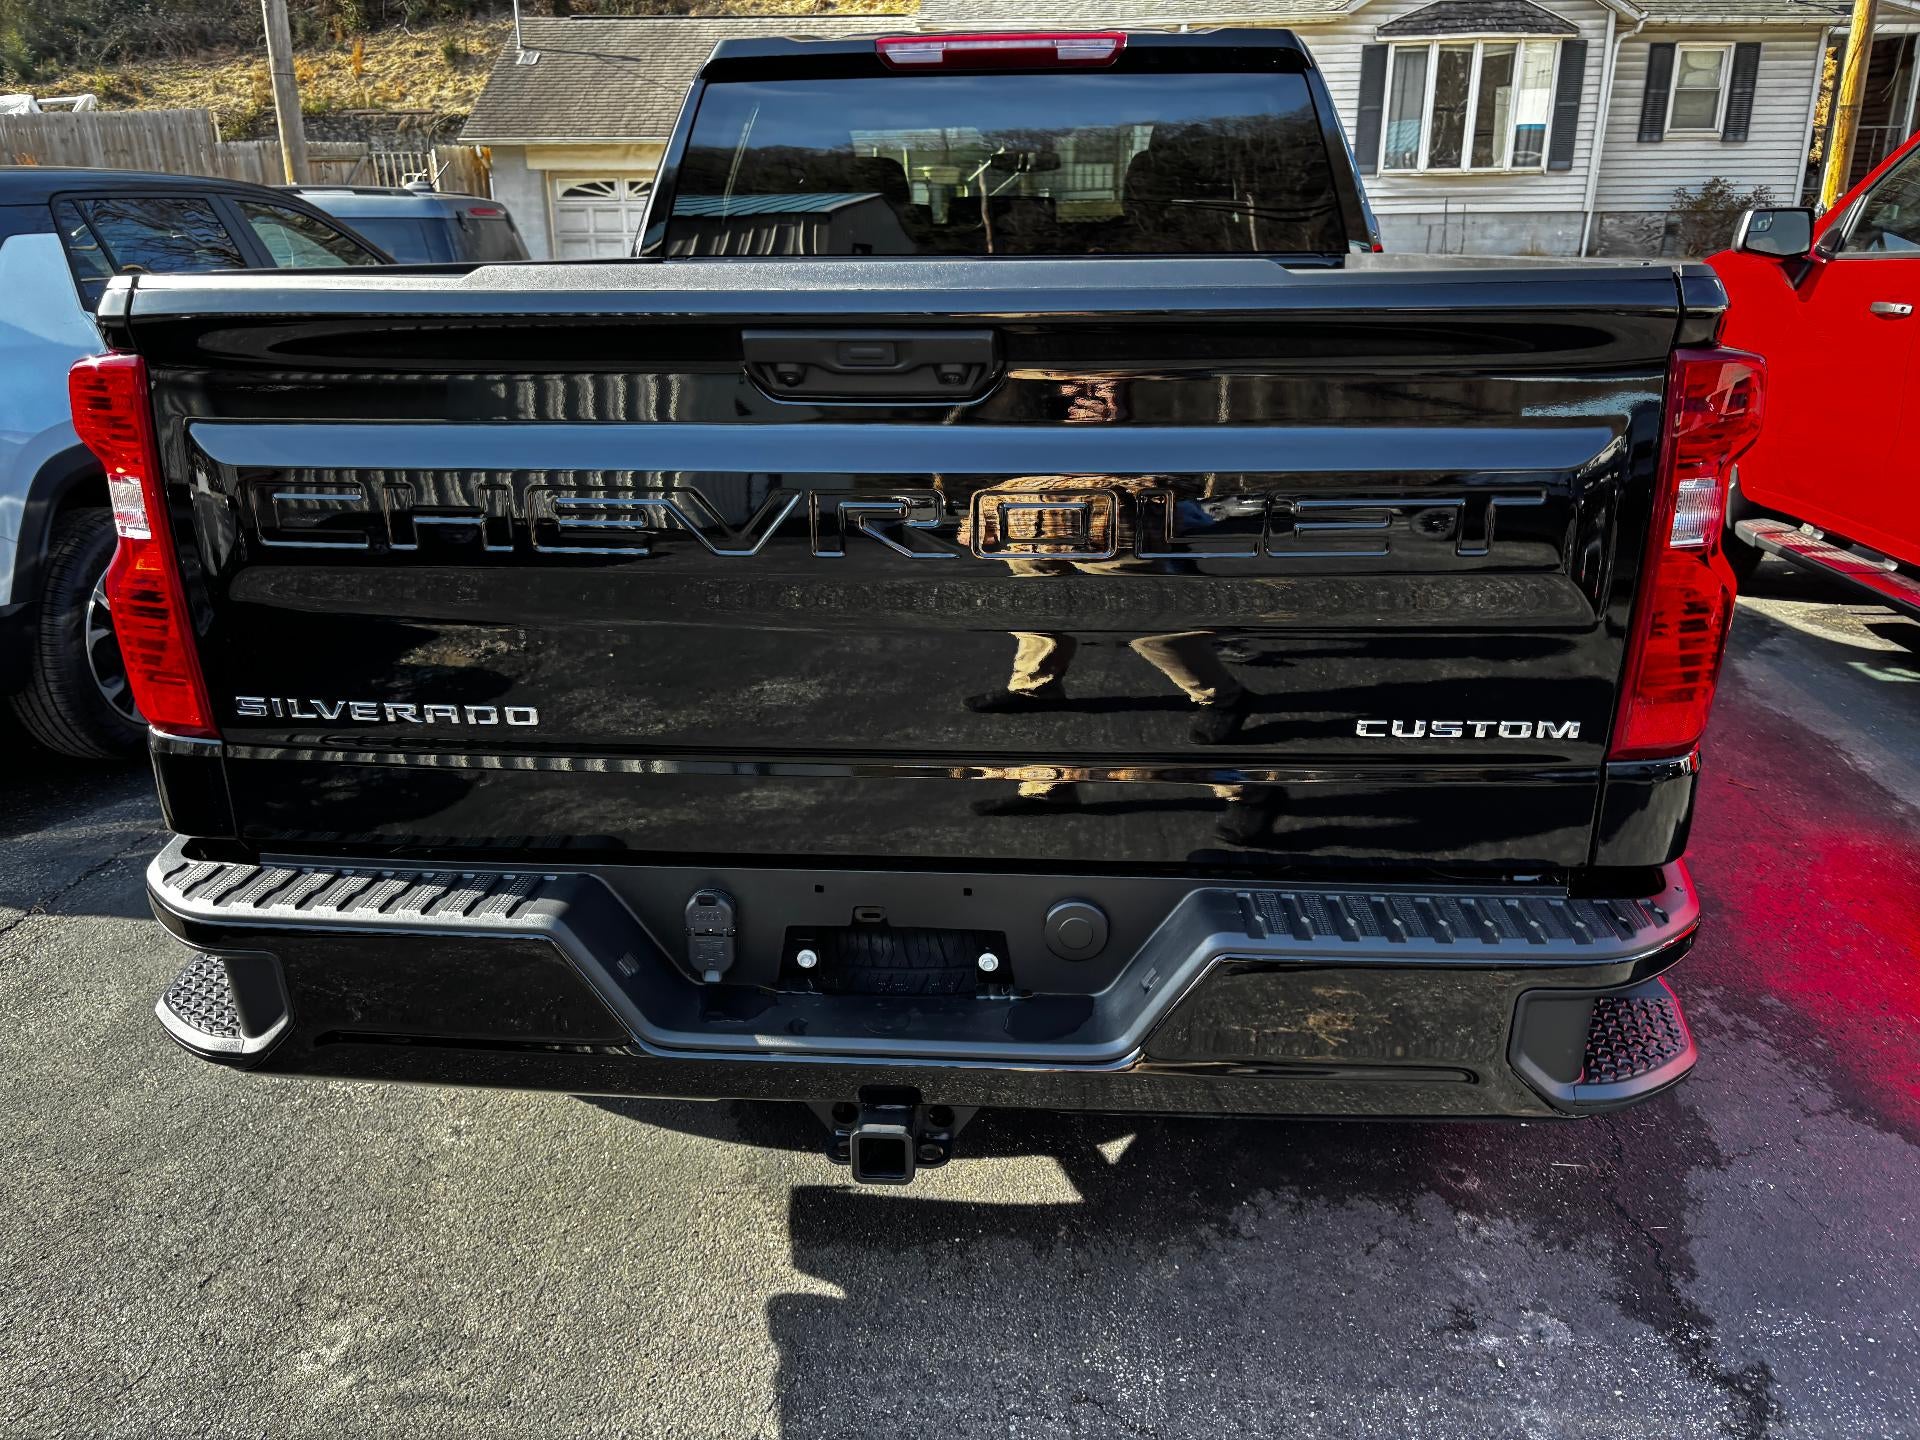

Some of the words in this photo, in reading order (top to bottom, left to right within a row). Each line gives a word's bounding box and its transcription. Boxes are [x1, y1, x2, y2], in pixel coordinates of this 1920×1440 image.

[253, 481, 1549, 558] CHEVROLET
[235, 696, 540, 727] SILVERADO
[1355, 719, 1582, 739] CUSTOM
